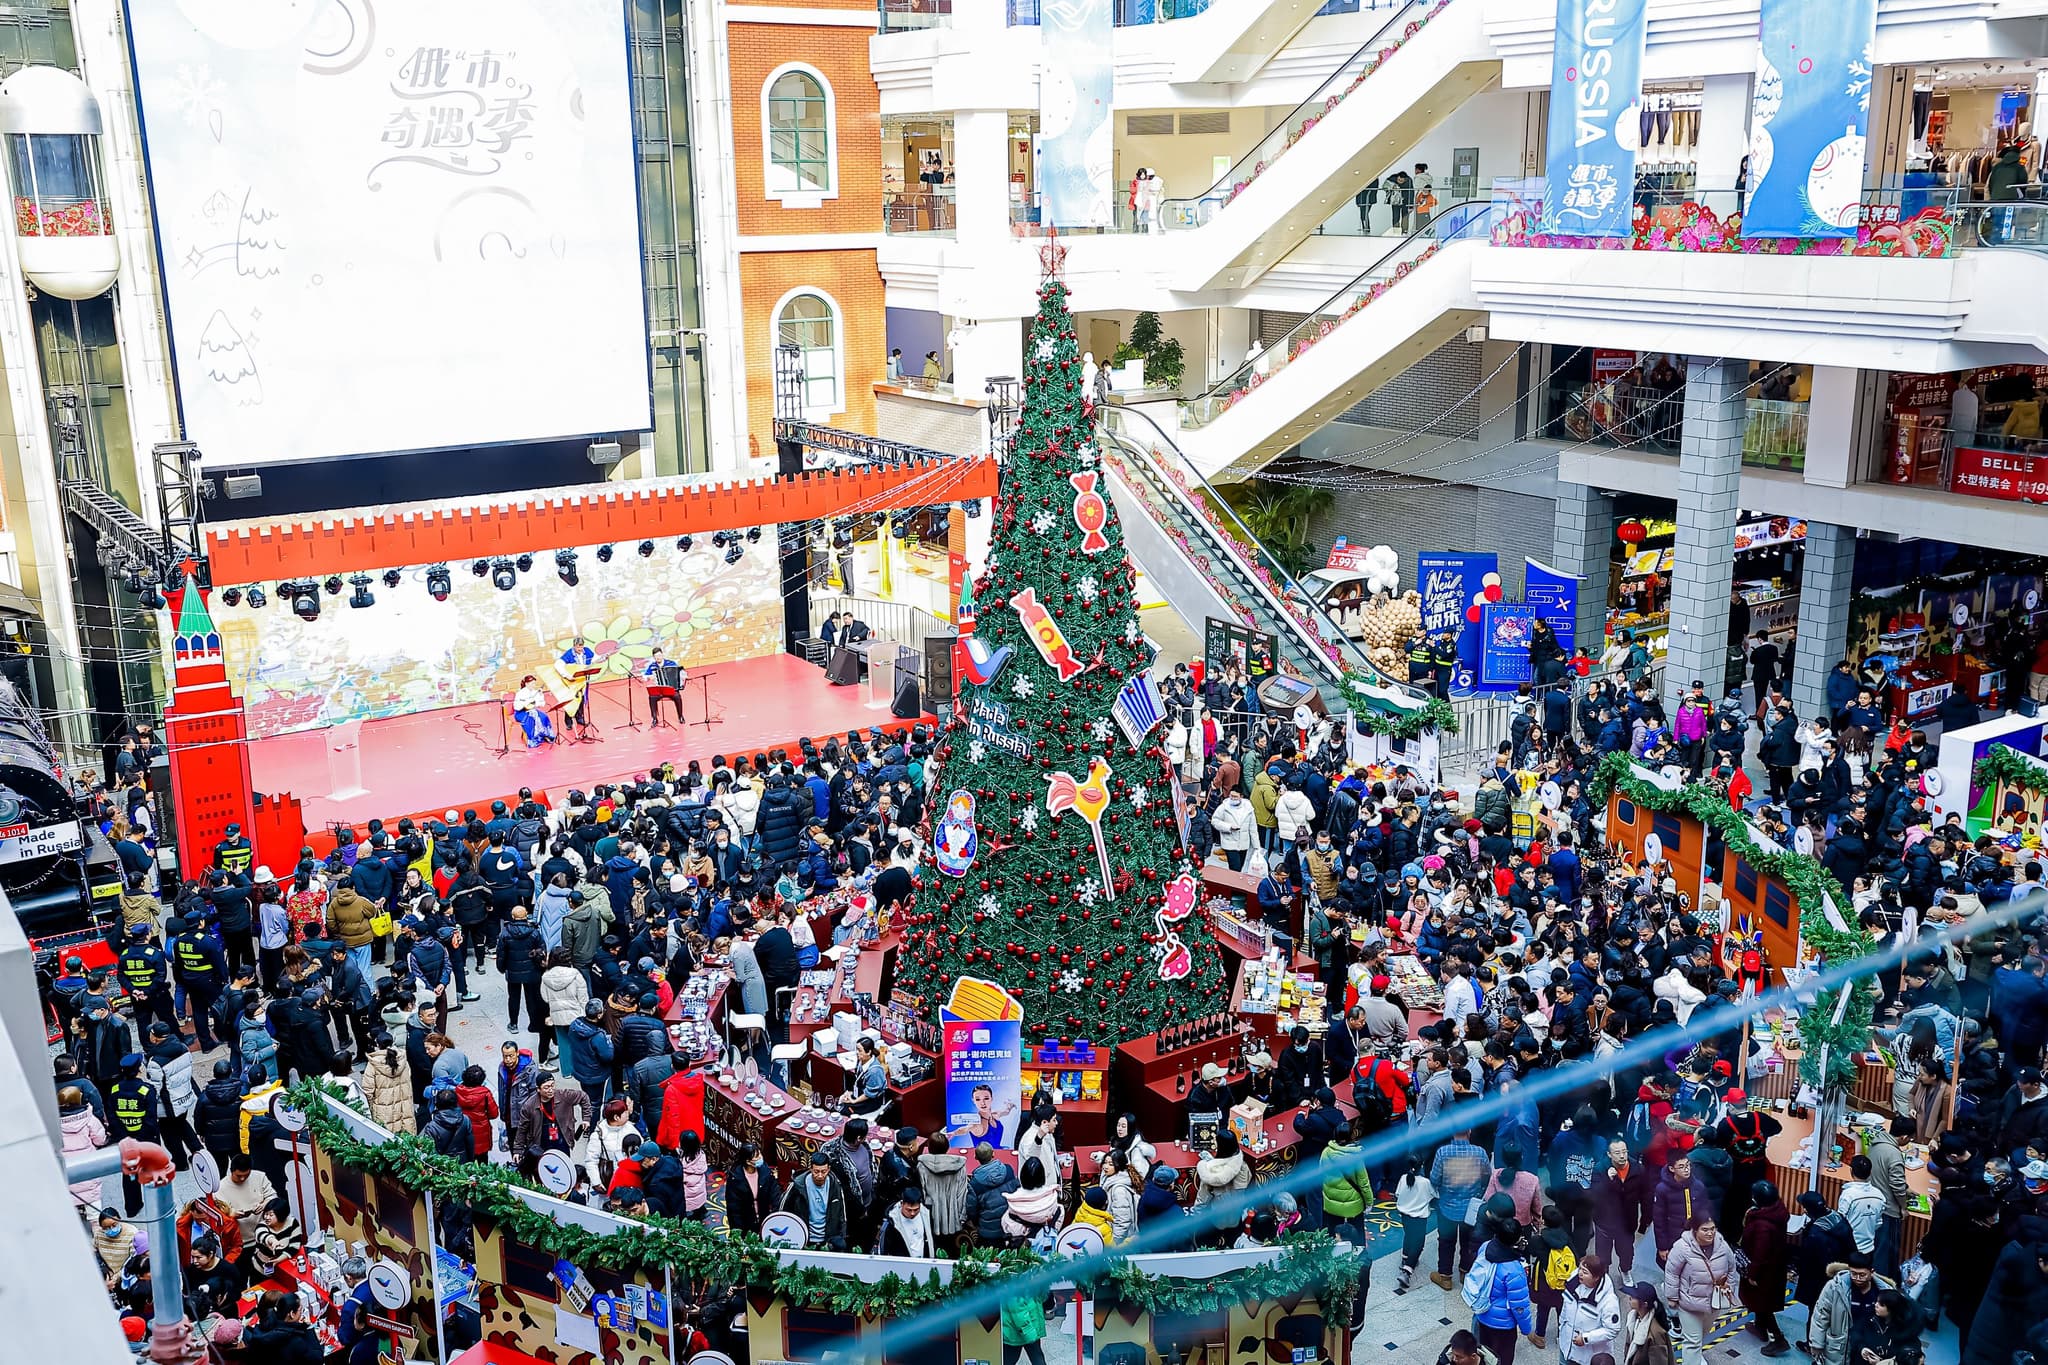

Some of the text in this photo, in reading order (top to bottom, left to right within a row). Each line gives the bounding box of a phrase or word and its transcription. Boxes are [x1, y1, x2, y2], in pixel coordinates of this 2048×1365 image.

[1575, 0, 1616, 148] RUSSIA
[381, 94, 537, 153] 奇遇季
[1916, 378, 1946, 391] BELLE
[1908, 390, 1949, 407] 大型特卖会
[1981, 457, 2035, 473] BELLE
[1957, 472, 2012, 490] 大型特卖会
[1425, 569, 1463, 601] New
[982, 724, 1027, 756] Russia
[8, 827, 26, 837] 1014
[18, 830, 55, 845] Made
[20, 838, 81, 858] in Russia
[117, 1098, 139, 1109] 警察
